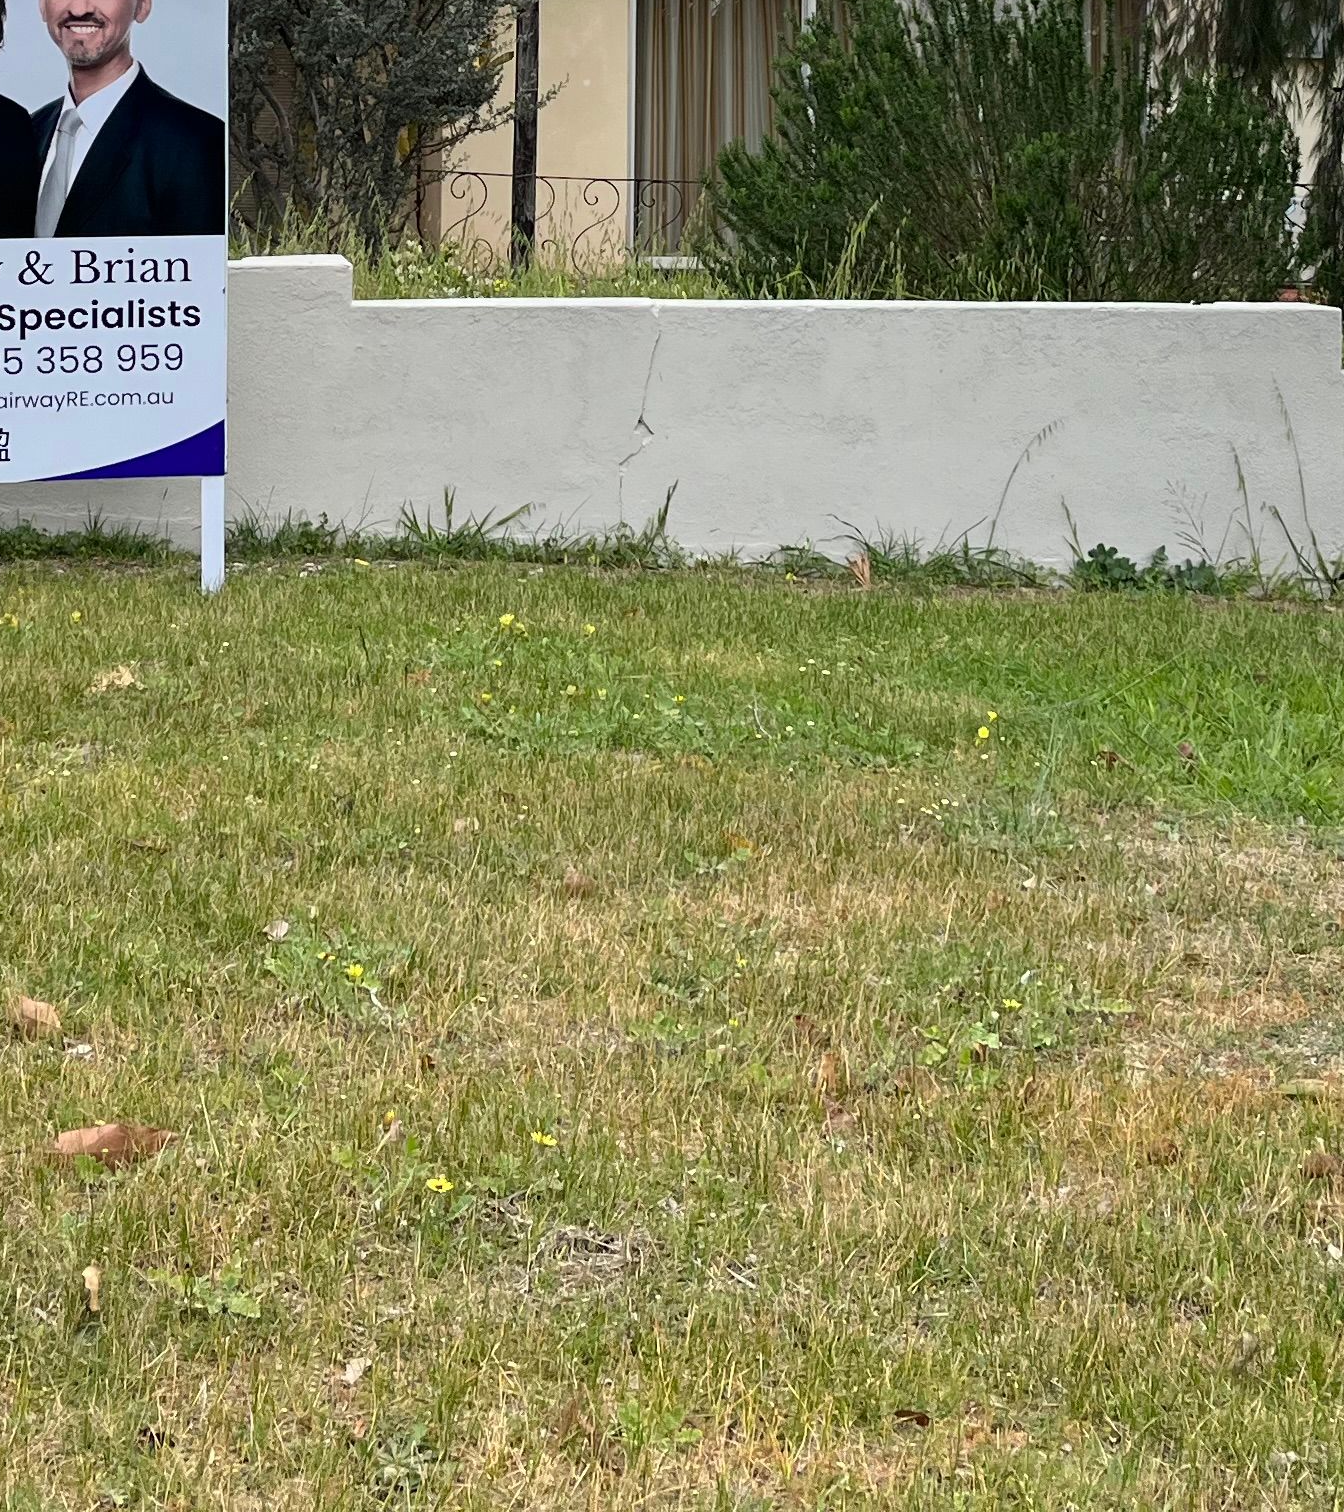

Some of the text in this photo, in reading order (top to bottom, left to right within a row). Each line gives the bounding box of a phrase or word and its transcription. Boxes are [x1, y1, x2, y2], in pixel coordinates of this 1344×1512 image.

[17, 250, 54, 286] &
[70, 247, 192, 285] Brian
[36, 345, 103, 375] 358
[117, 343, 184, 372] 959
